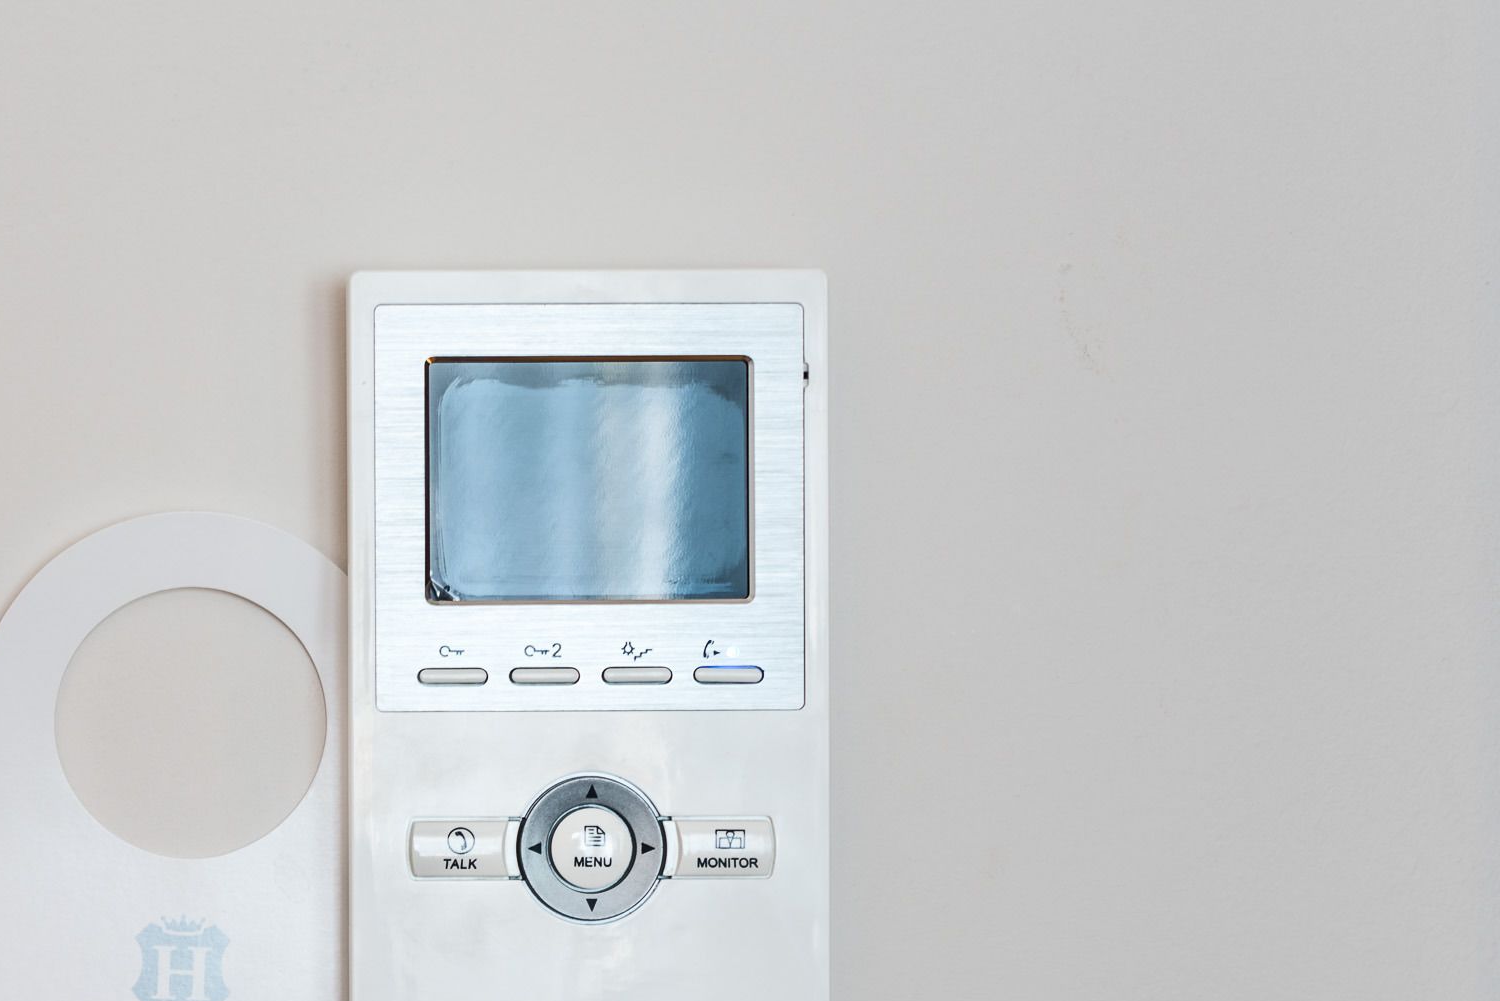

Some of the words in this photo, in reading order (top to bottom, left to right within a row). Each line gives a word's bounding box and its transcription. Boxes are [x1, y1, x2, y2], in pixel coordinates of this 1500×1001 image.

[552, 643, 562, 658] 2
[443, 858, 478, 870] TALK
[573, 856, 612, 868] MENU
[696, 857, 759, 869] MONITOR
[151, 945, 213, 1001] H
